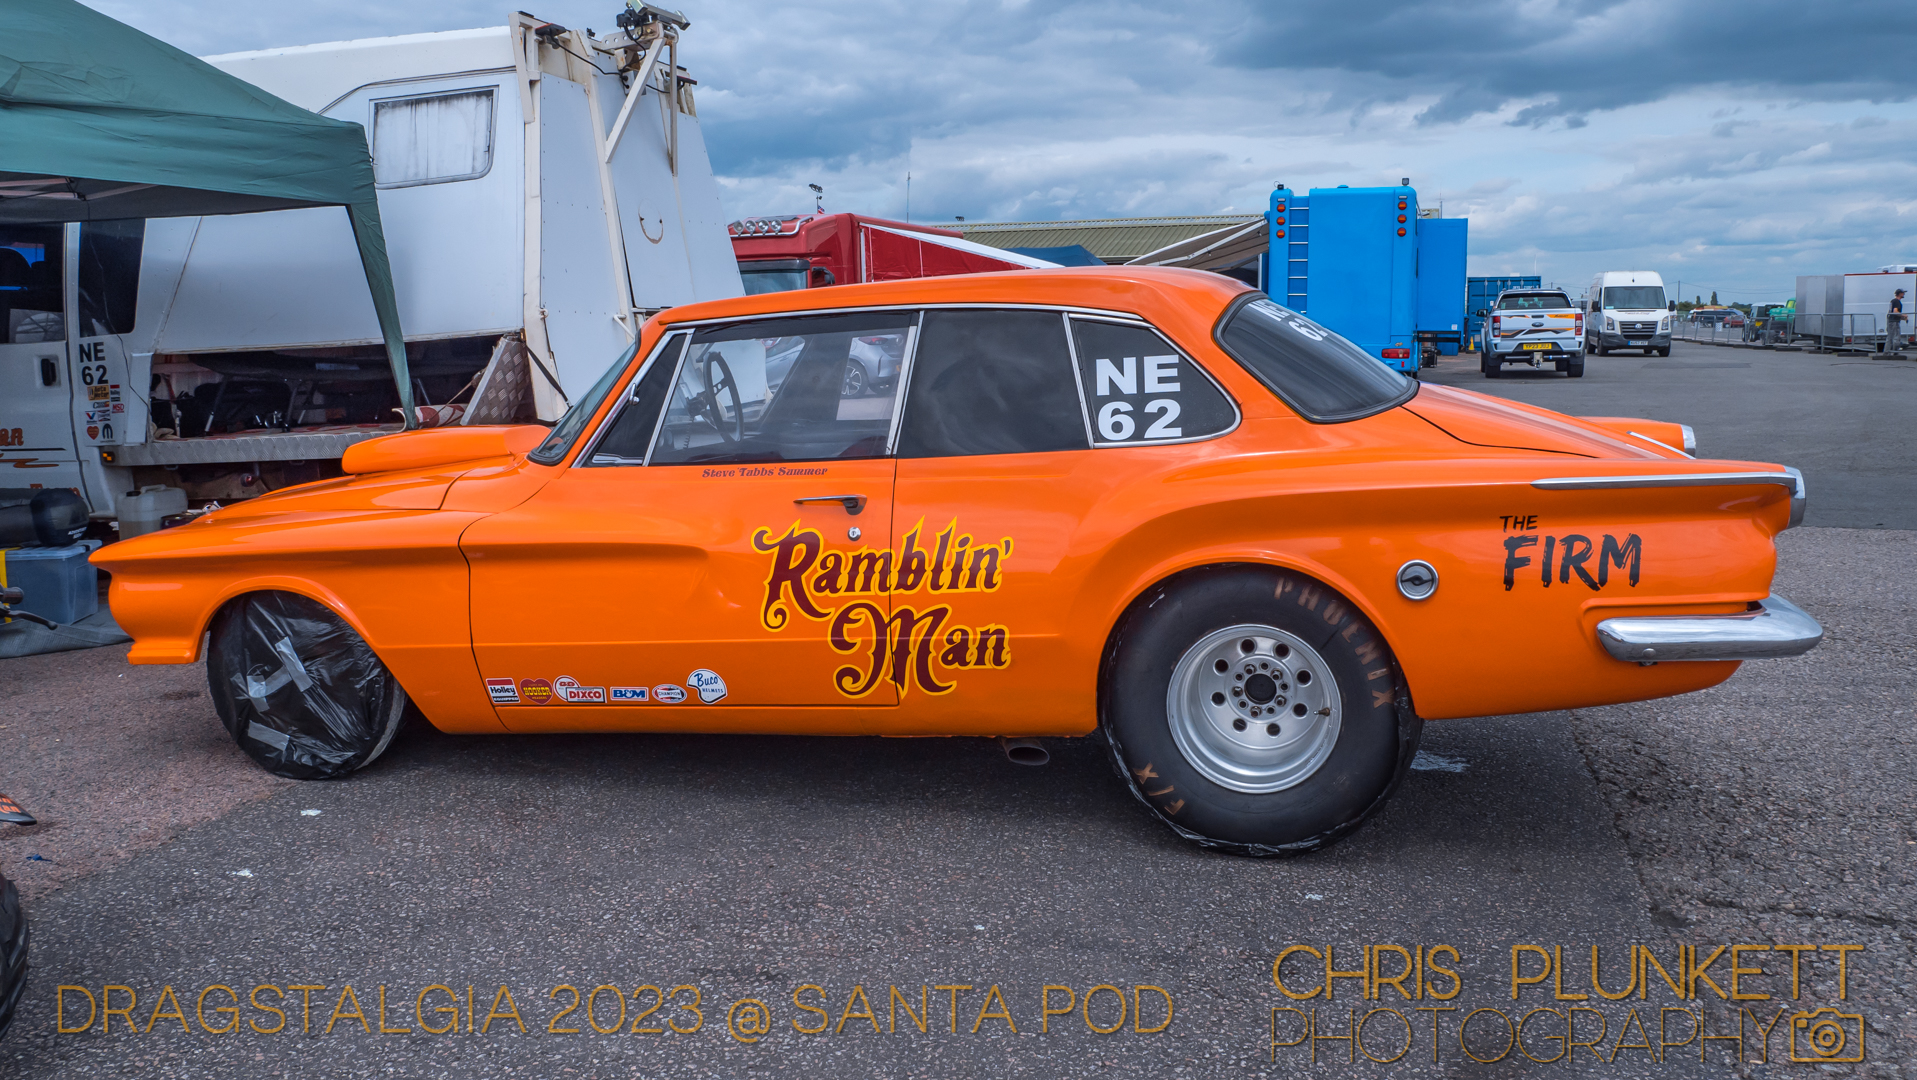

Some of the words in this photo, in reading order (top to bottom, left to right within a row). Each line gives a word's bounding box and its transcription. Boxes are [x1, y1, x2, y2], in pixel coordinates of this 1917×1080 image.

[1288, 318, 1328, 341] 62
[79, 342, 106, 363] NE
[82, 365, 108, 385] 62
[1095, 355, 1182, 396] NE
[1099, 399, 1182, 441] 62
[702, 469, 736, 478] Steve
[777, 466, 828, 476] Summer
[1499, 515, 1538, 532] THE
[1503, 533, 1642, 591] FIRM
[751, 515, 1014, 632] Ramblin'
[828, 600, 1011, 698] Man
[1274, 576, 1394, 708] PHOENIX
[693, 673, 718, 687] Buco
[490, 686, 516, 695] Holley
[523, 687, 552, 696] HOOKER
[569, 690, 602, 699] DIXCO
[613, 689, 646, 699] B&M
